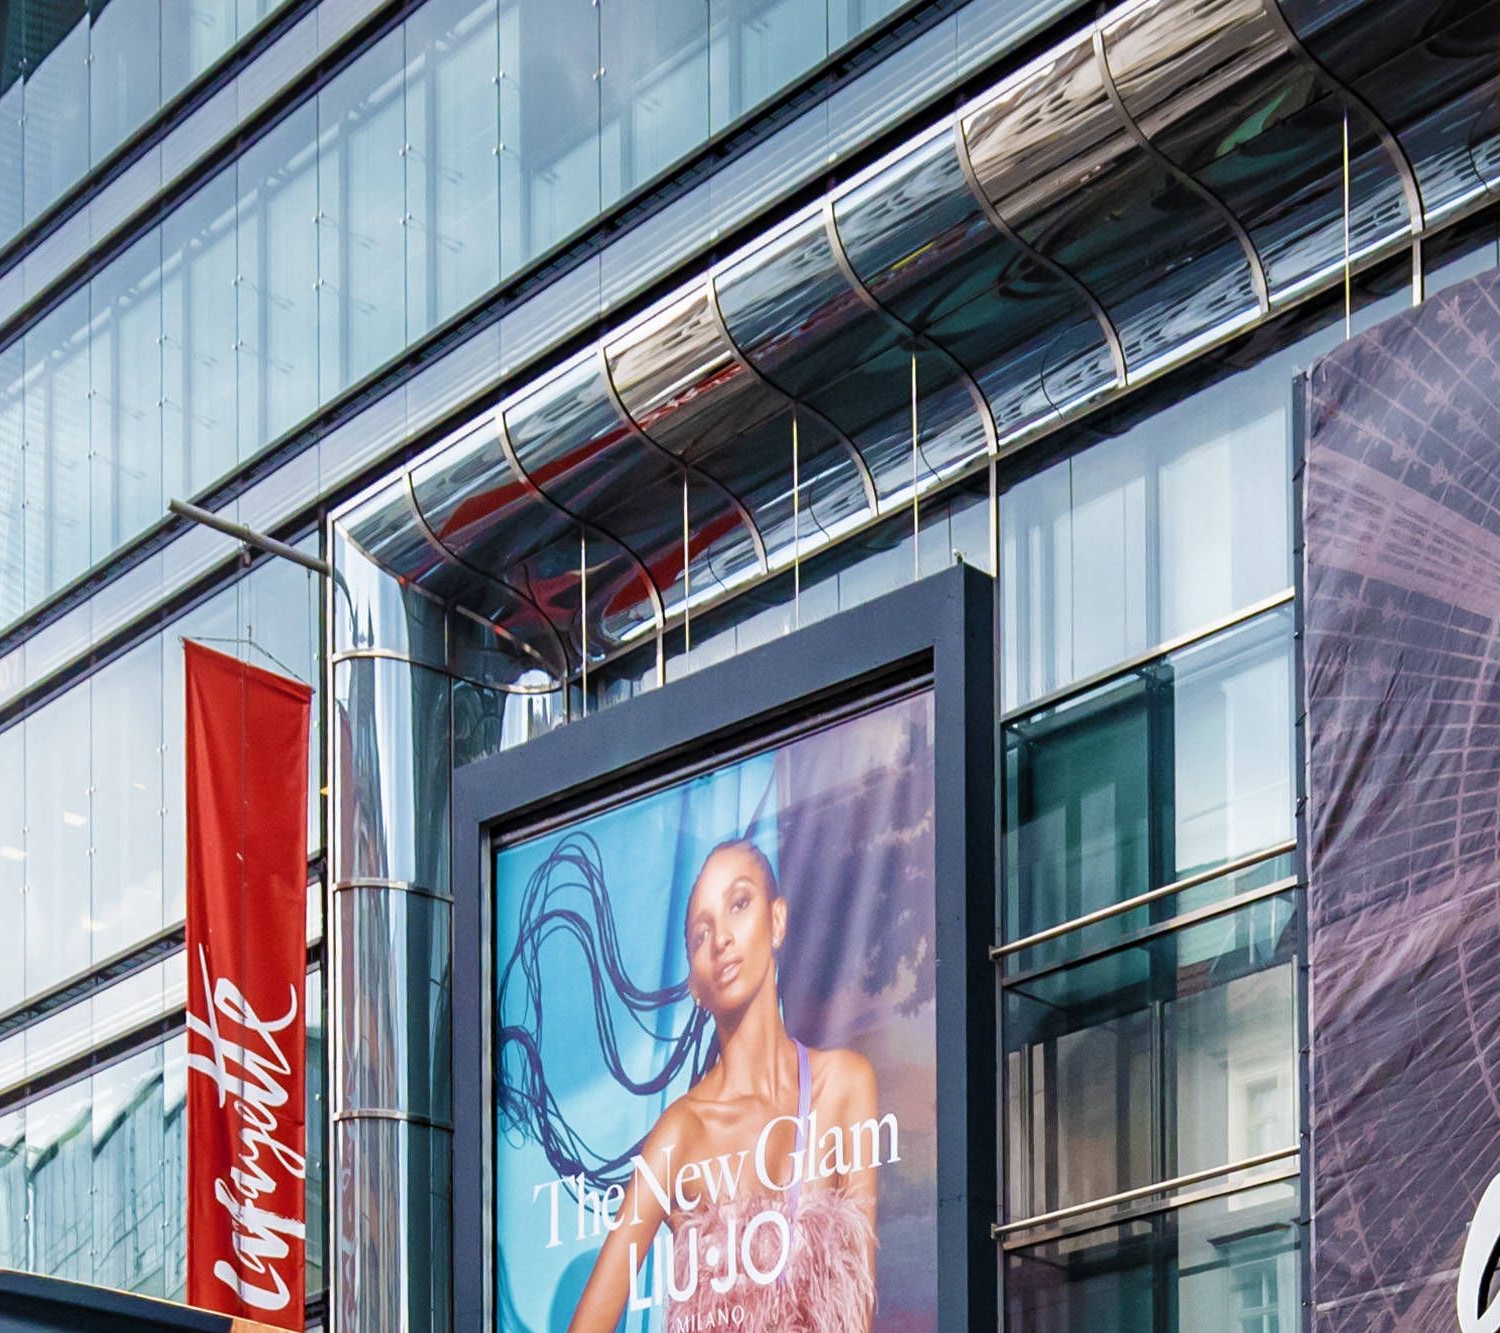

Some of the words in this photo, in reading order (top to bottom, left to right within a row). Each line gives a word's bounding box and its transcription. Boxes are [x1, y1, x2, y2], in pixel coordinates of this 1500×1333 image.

[186, 942, 306, 1311] Lafayette
[533, 1171, 626, 1248] The
[629, 1144, 749, 1226] New
[754, 1109, 901, 1192] Glam
